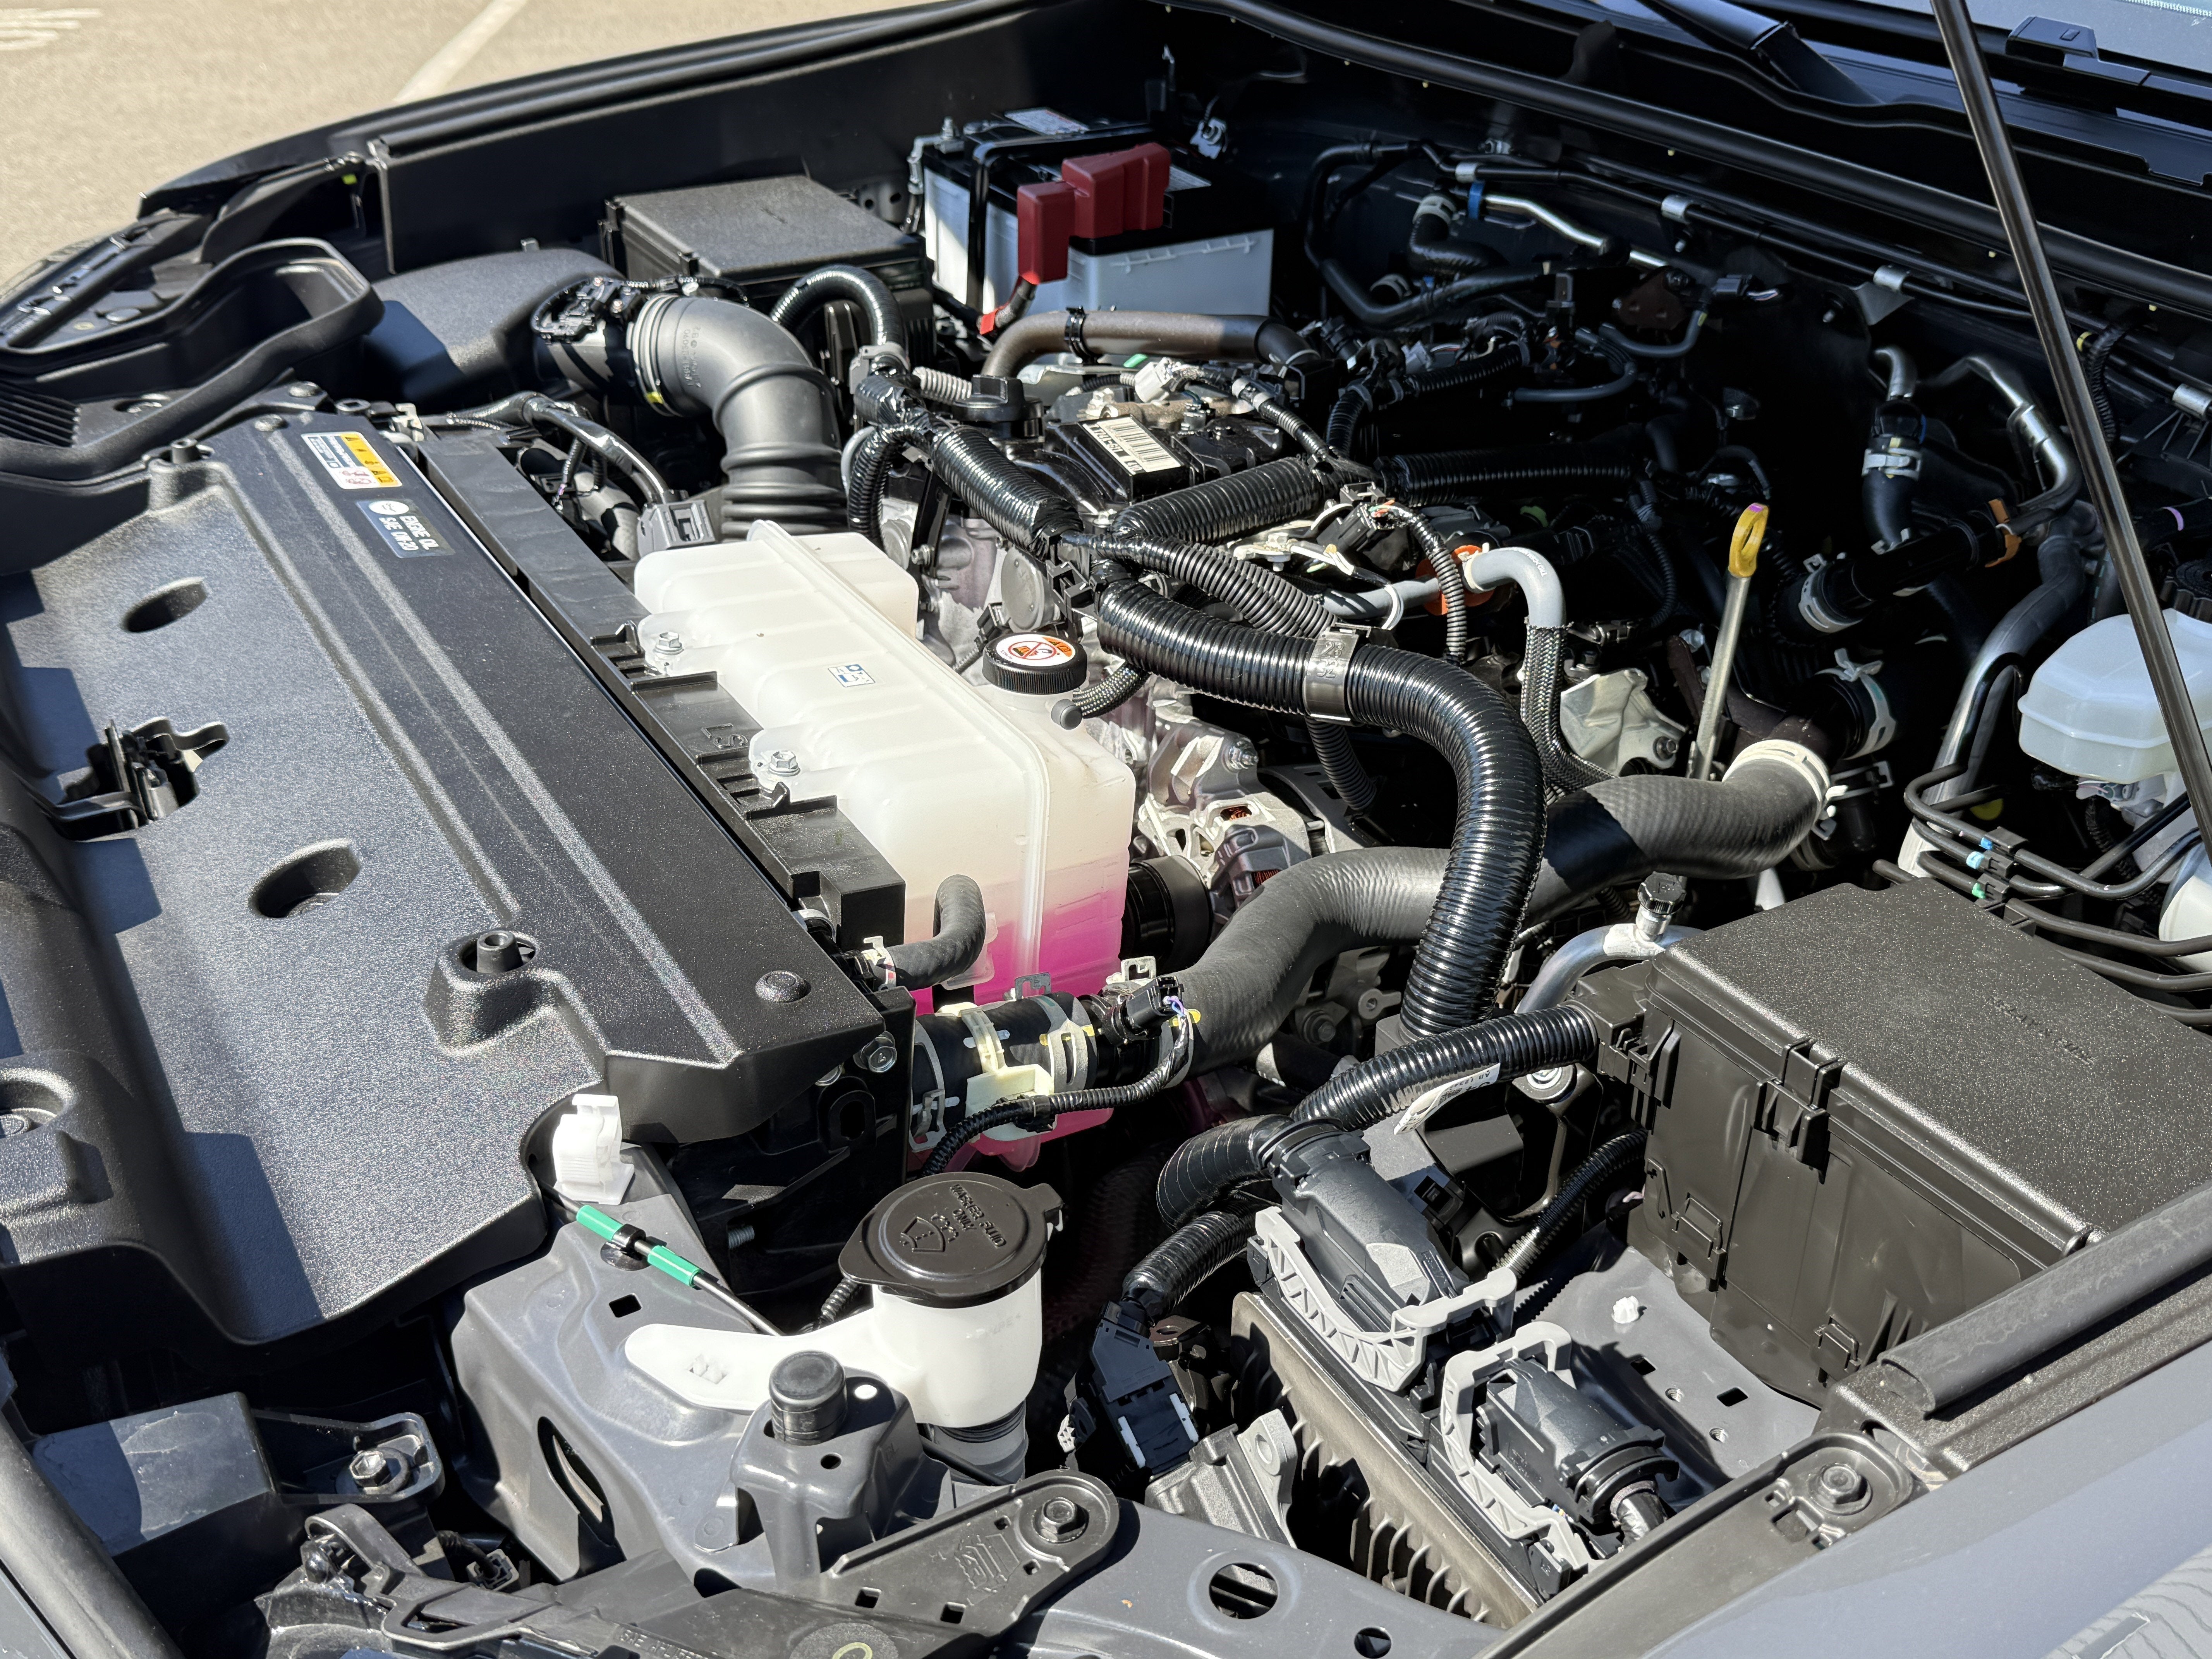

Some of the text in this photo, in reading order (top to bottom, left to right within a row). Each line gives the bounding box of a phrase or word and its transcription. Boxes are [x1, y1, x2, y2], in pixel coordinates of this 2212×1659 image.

[379, 517, 419, 551] SAE 0W-20
[399, 515, 439, 550] ENGINE OIL
[1320, 641, 1345, 659] 28
[1316, 659, 1339, 678] 32
[1982, 996, 2042, 1027] RELAY
[2053, 1037, 2099, 1065] FUSE
[950, 1184, 1007, 1249] WASHER FLUID
[953, 1209, 977, 1231] ONLY
